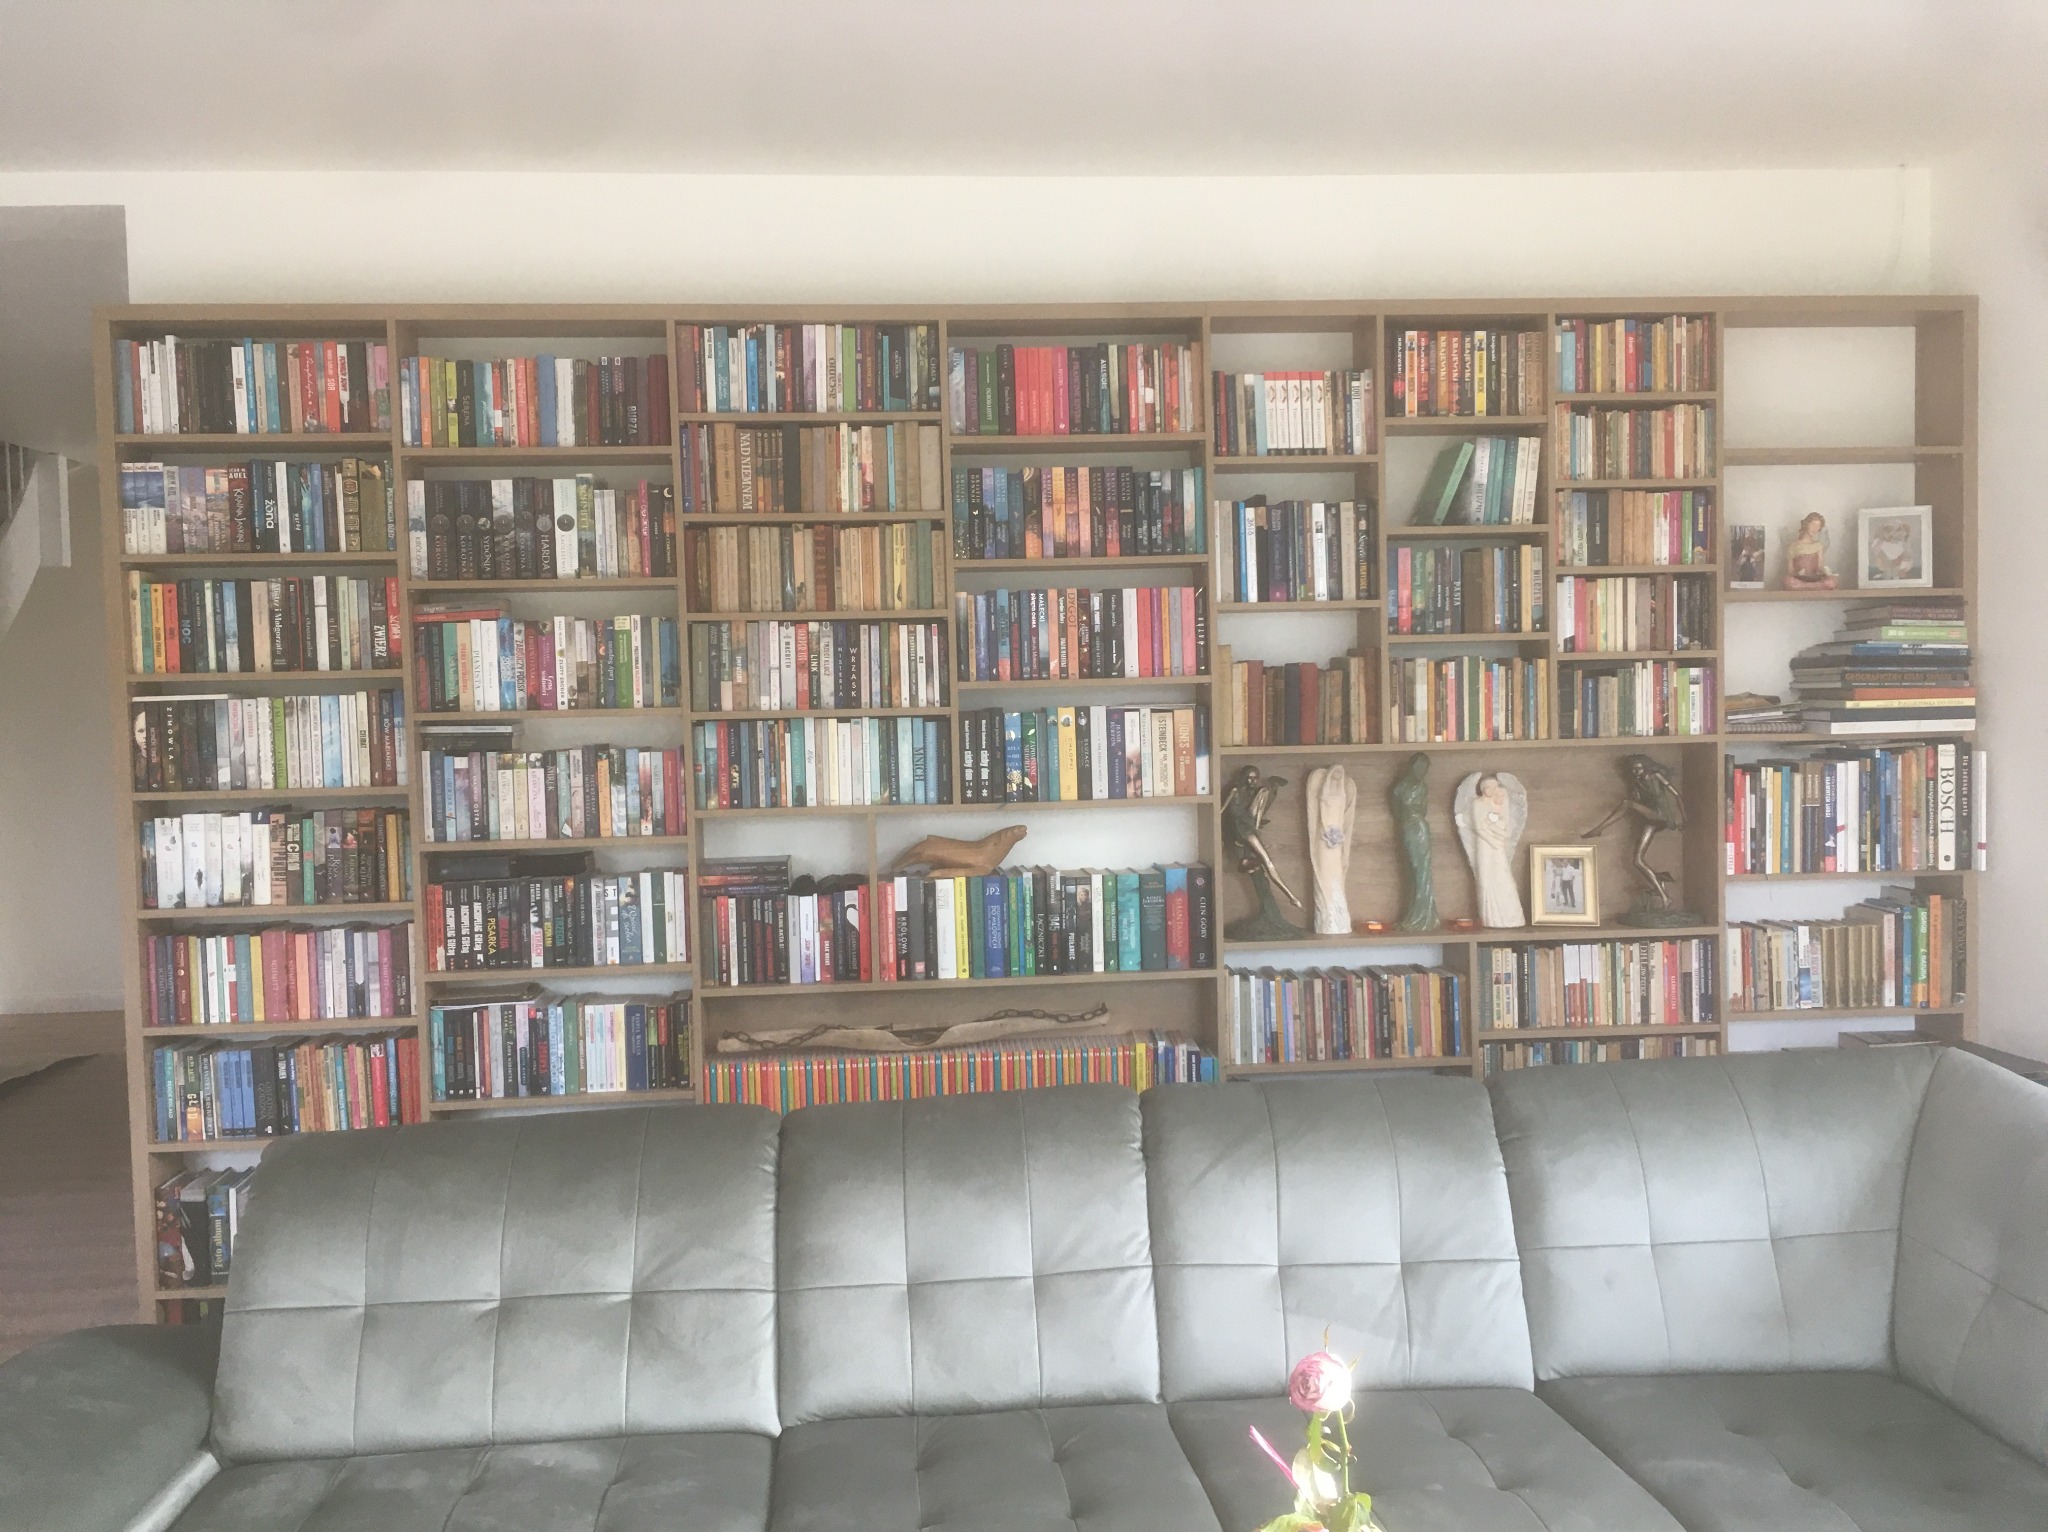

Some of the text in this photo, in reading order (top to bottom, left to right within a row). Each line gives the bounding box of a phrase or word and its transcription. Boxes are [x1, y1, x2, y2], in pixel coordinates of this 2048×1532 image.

[1439, 336, 1447, 380] KRAJEWSKI
[1452, 338, 1460, 381] KRAJEWSKI
[462, 395, 471, 426] SERENA
[627, 405, 637, 435] BURZA
[740, 433, 752, 510] NAD NIEMNEM
[265, 499, 277, 528] żona
[541, 534, 550, 570] HARDA
[1533, 569, 1542, 607] MILCZENIE
[1068, 592, 1076, 627] DYGOT
[182, 620, 191, 644] NOC
[374, 625, 387, 656] ZWIERZ
[784, 641, 792, 669] MACBETH
[517, 670, 525, 693] POCISK
[849, 647, 858, 697] WRZASK
[383, 718, 391, 733] RÓW
[1158, 719, 1168, 752] STEINBECK
[1179, 723, 1189, 748] JONES
[546, 765, 555, 791] MIREK
[914, 747, 924, 782] MNICH
[1940, 767, 1954, 833] BOSCH
[446, 908, 455, 937] ARCHIPELAG
[460, 905, 469, 935] ARCHIPELAG
[473, 902, 483, 932] ARCHIPELAG
[1048, 914, 1061, 931] 1945
[487, 917, 496, 955] PISARKA
[900, 917, 908, 954] KRÓLOWA
[1036, 913, 1045, 958] ŁĄCZNICZKI
[1640, 964, 1648, 996] Lawrence
[549, 1008, 558, 1084] CHARLOTTE WOOD
